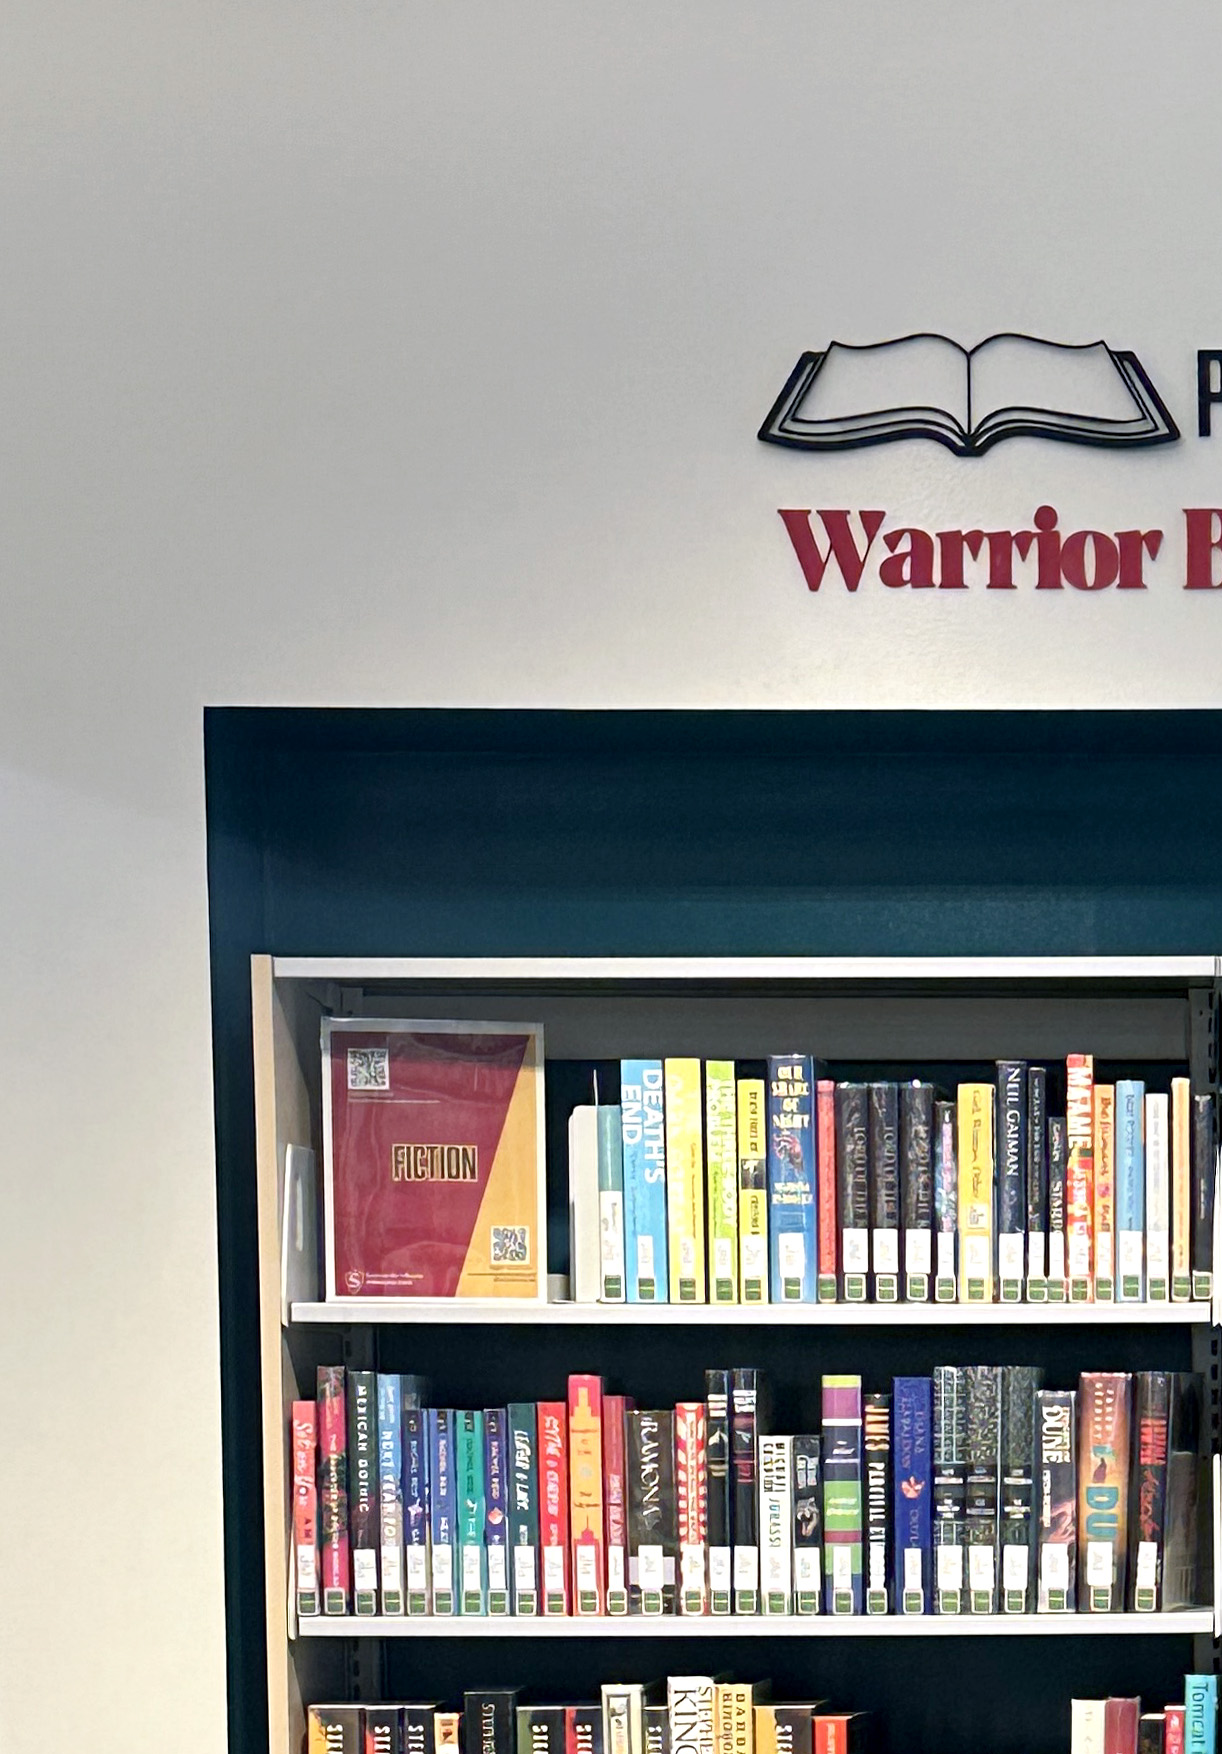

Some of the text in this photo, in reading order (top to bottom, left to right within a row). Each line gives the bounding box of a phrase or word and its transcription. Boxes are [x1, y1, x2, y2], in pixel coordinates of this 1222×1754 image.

[778, 504, 1163, 593] Warrior
[622, 1085, 642, 1144] END
[643, 1069, 664, 1183] DEATH'S
[1006, 1067, 1021, 1177] NEIL GAIMAN
[1067, 1066, 1091, 1148] MAAME
[392, 1144, 478, 1181] FICTION
[356, 1385, 369, 1513] MEXICAN GOTHIC
[865, 1405, 889, 1451] JAMES
[1042, 1406, 1063, 1463] DUNE
[1191, 1683, 1209, 1744] Tomcat
